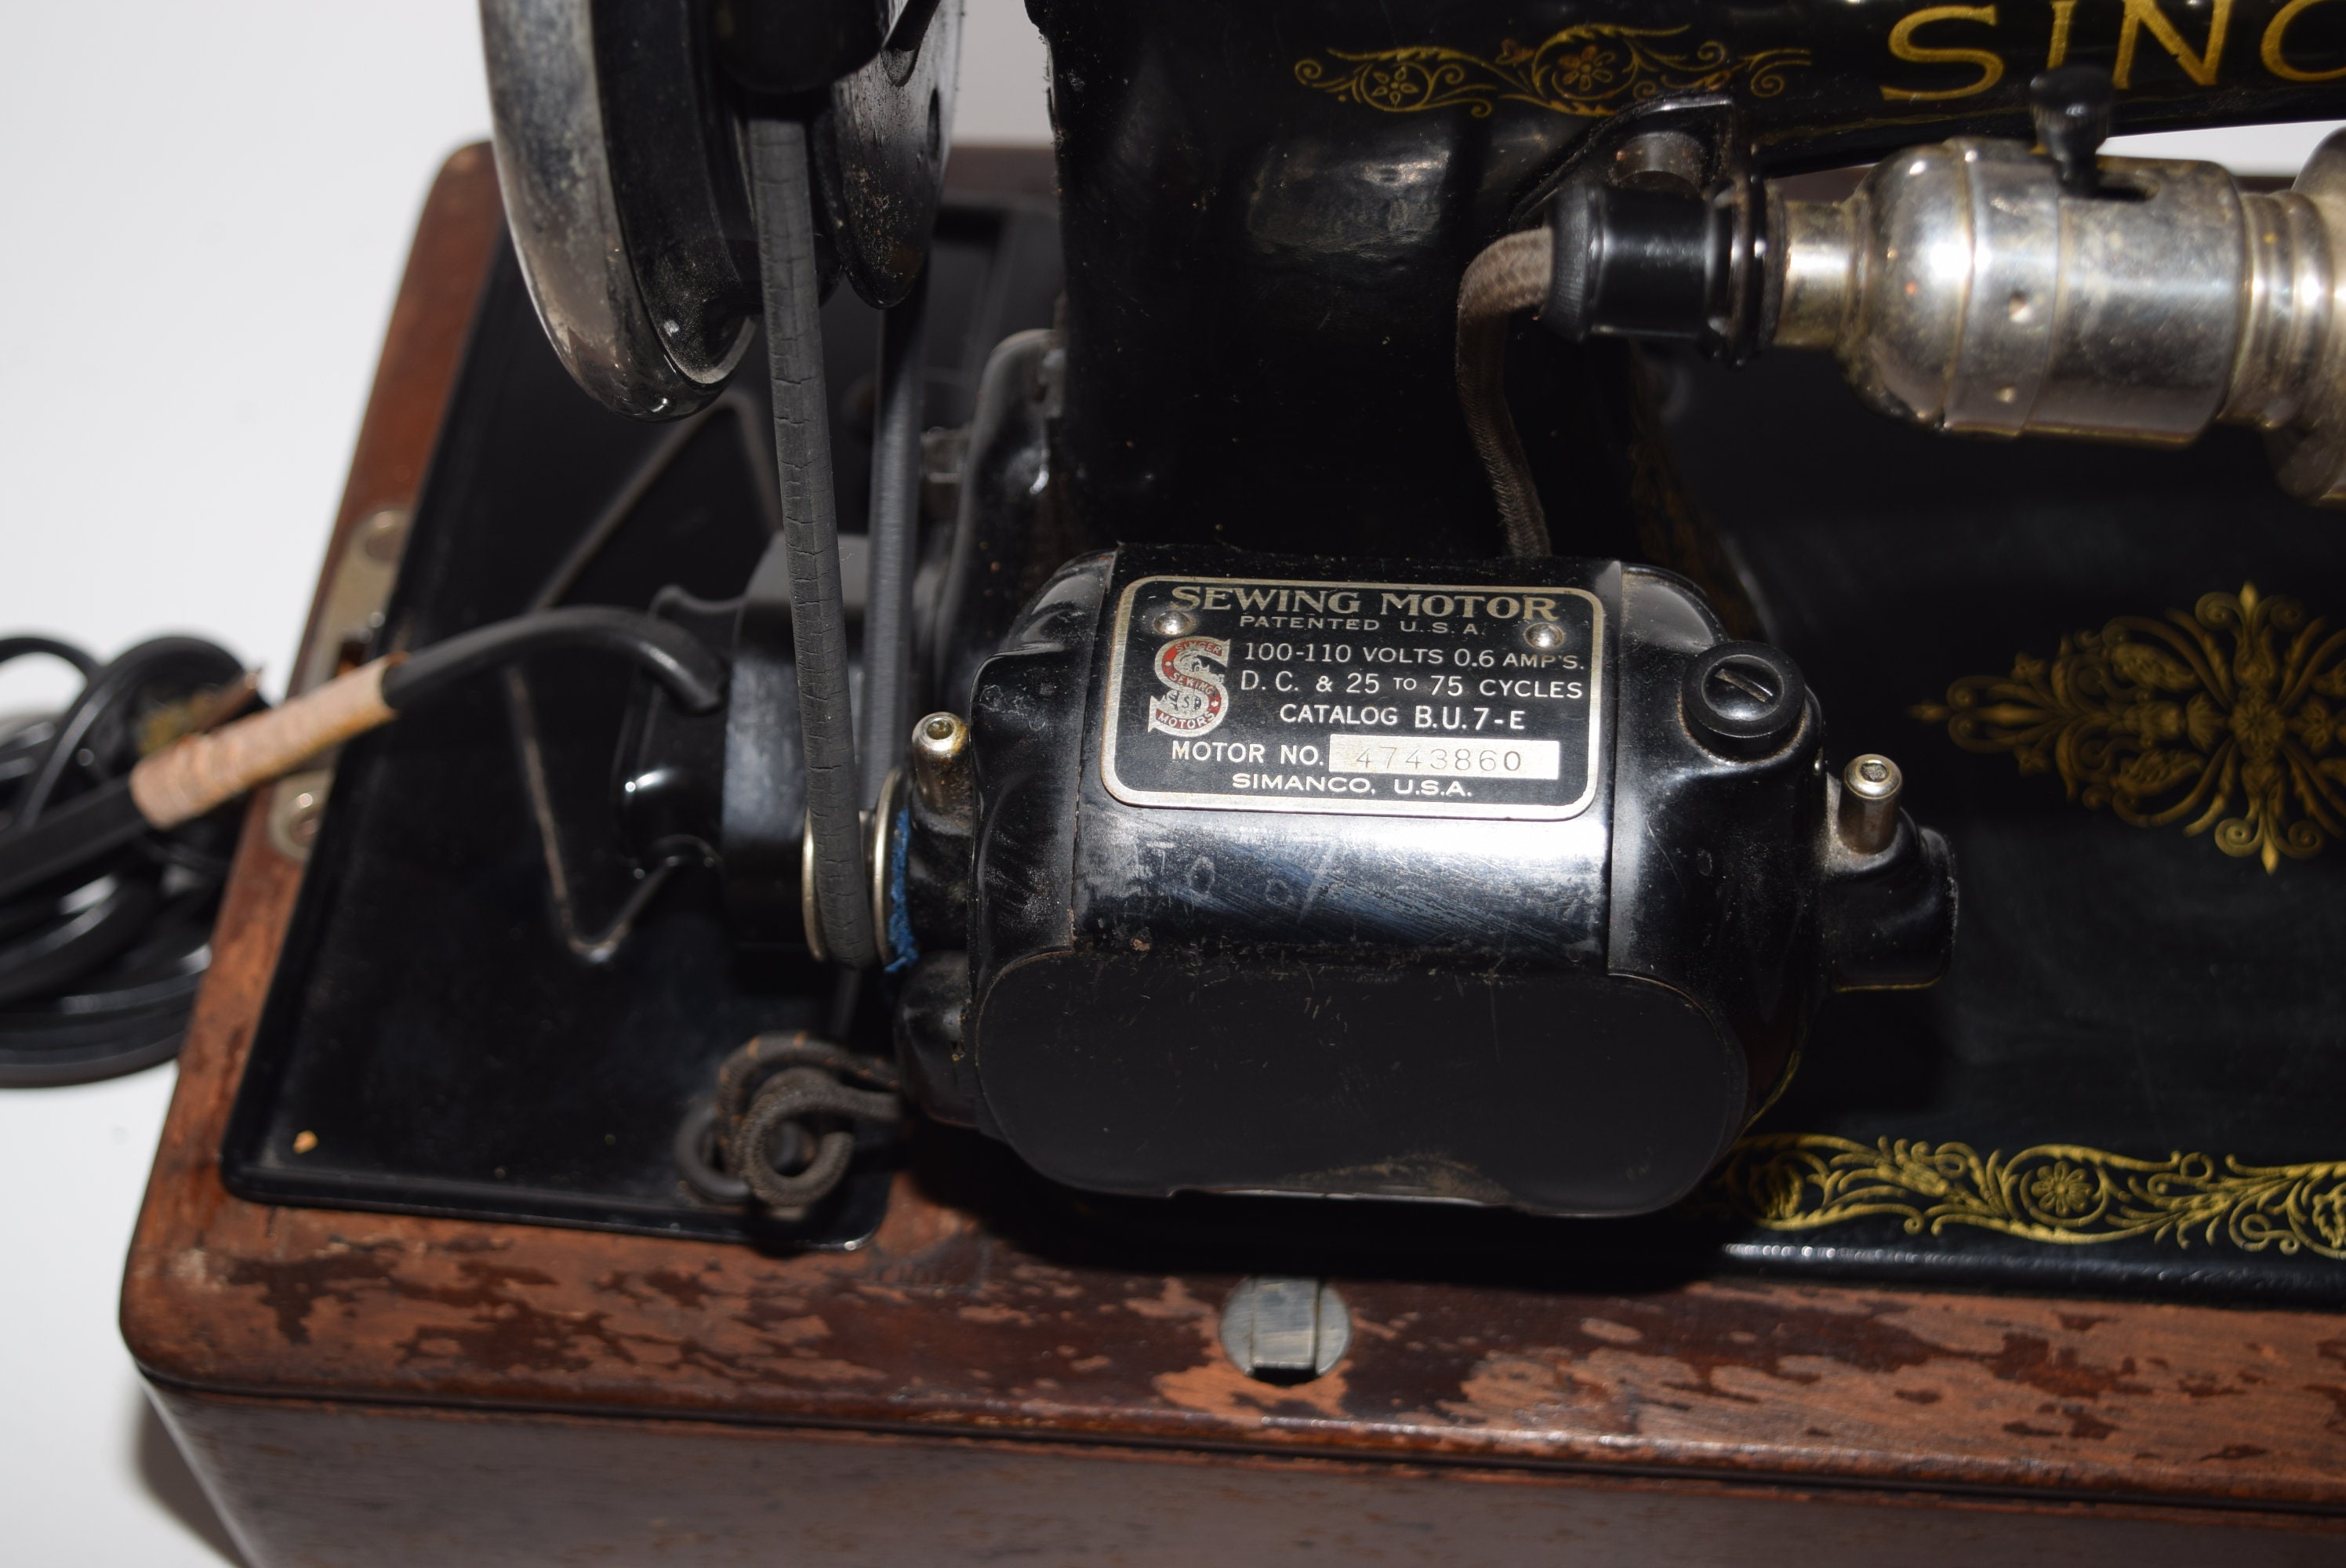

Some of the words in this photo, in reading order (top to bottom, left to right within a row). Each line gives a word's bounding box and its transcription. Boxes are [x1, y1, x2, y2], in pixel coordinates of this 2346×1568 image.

[1169, 586, 1361, 615] SEWING
[1380, 592, 1559, 622] MOTOR
[1240, 615, 1380, 631] PATENTED
[1245, 642, 1352, 663] 100-110
[1363, 647, 1444, 664] VOLTS
[1454, 648, 1494, 668] 0.6
[1502, 652, 1585, 670] AMP'S.
[1315, 675, 1334, 693] &
[1347, 672, 1380, 694] 25
[1393, 677, 1418, 691] TO
[1430, 675, 1463, 697] 75
[1479, 679, 1583, 699] CYCLES
[1157, 711, 1215, 729] MOTORS
[1280, 703, 1398, 726] CATALOG
[1171, 740, 1266, 764] MOTOR
[1280, 744, 1324, 766] NO.
[1355, 746, 1521, 771] 4743860
[1232, 772, 1376, 795] SIMANCO,
[1394, 779, 1473, 797] U.S.A.
